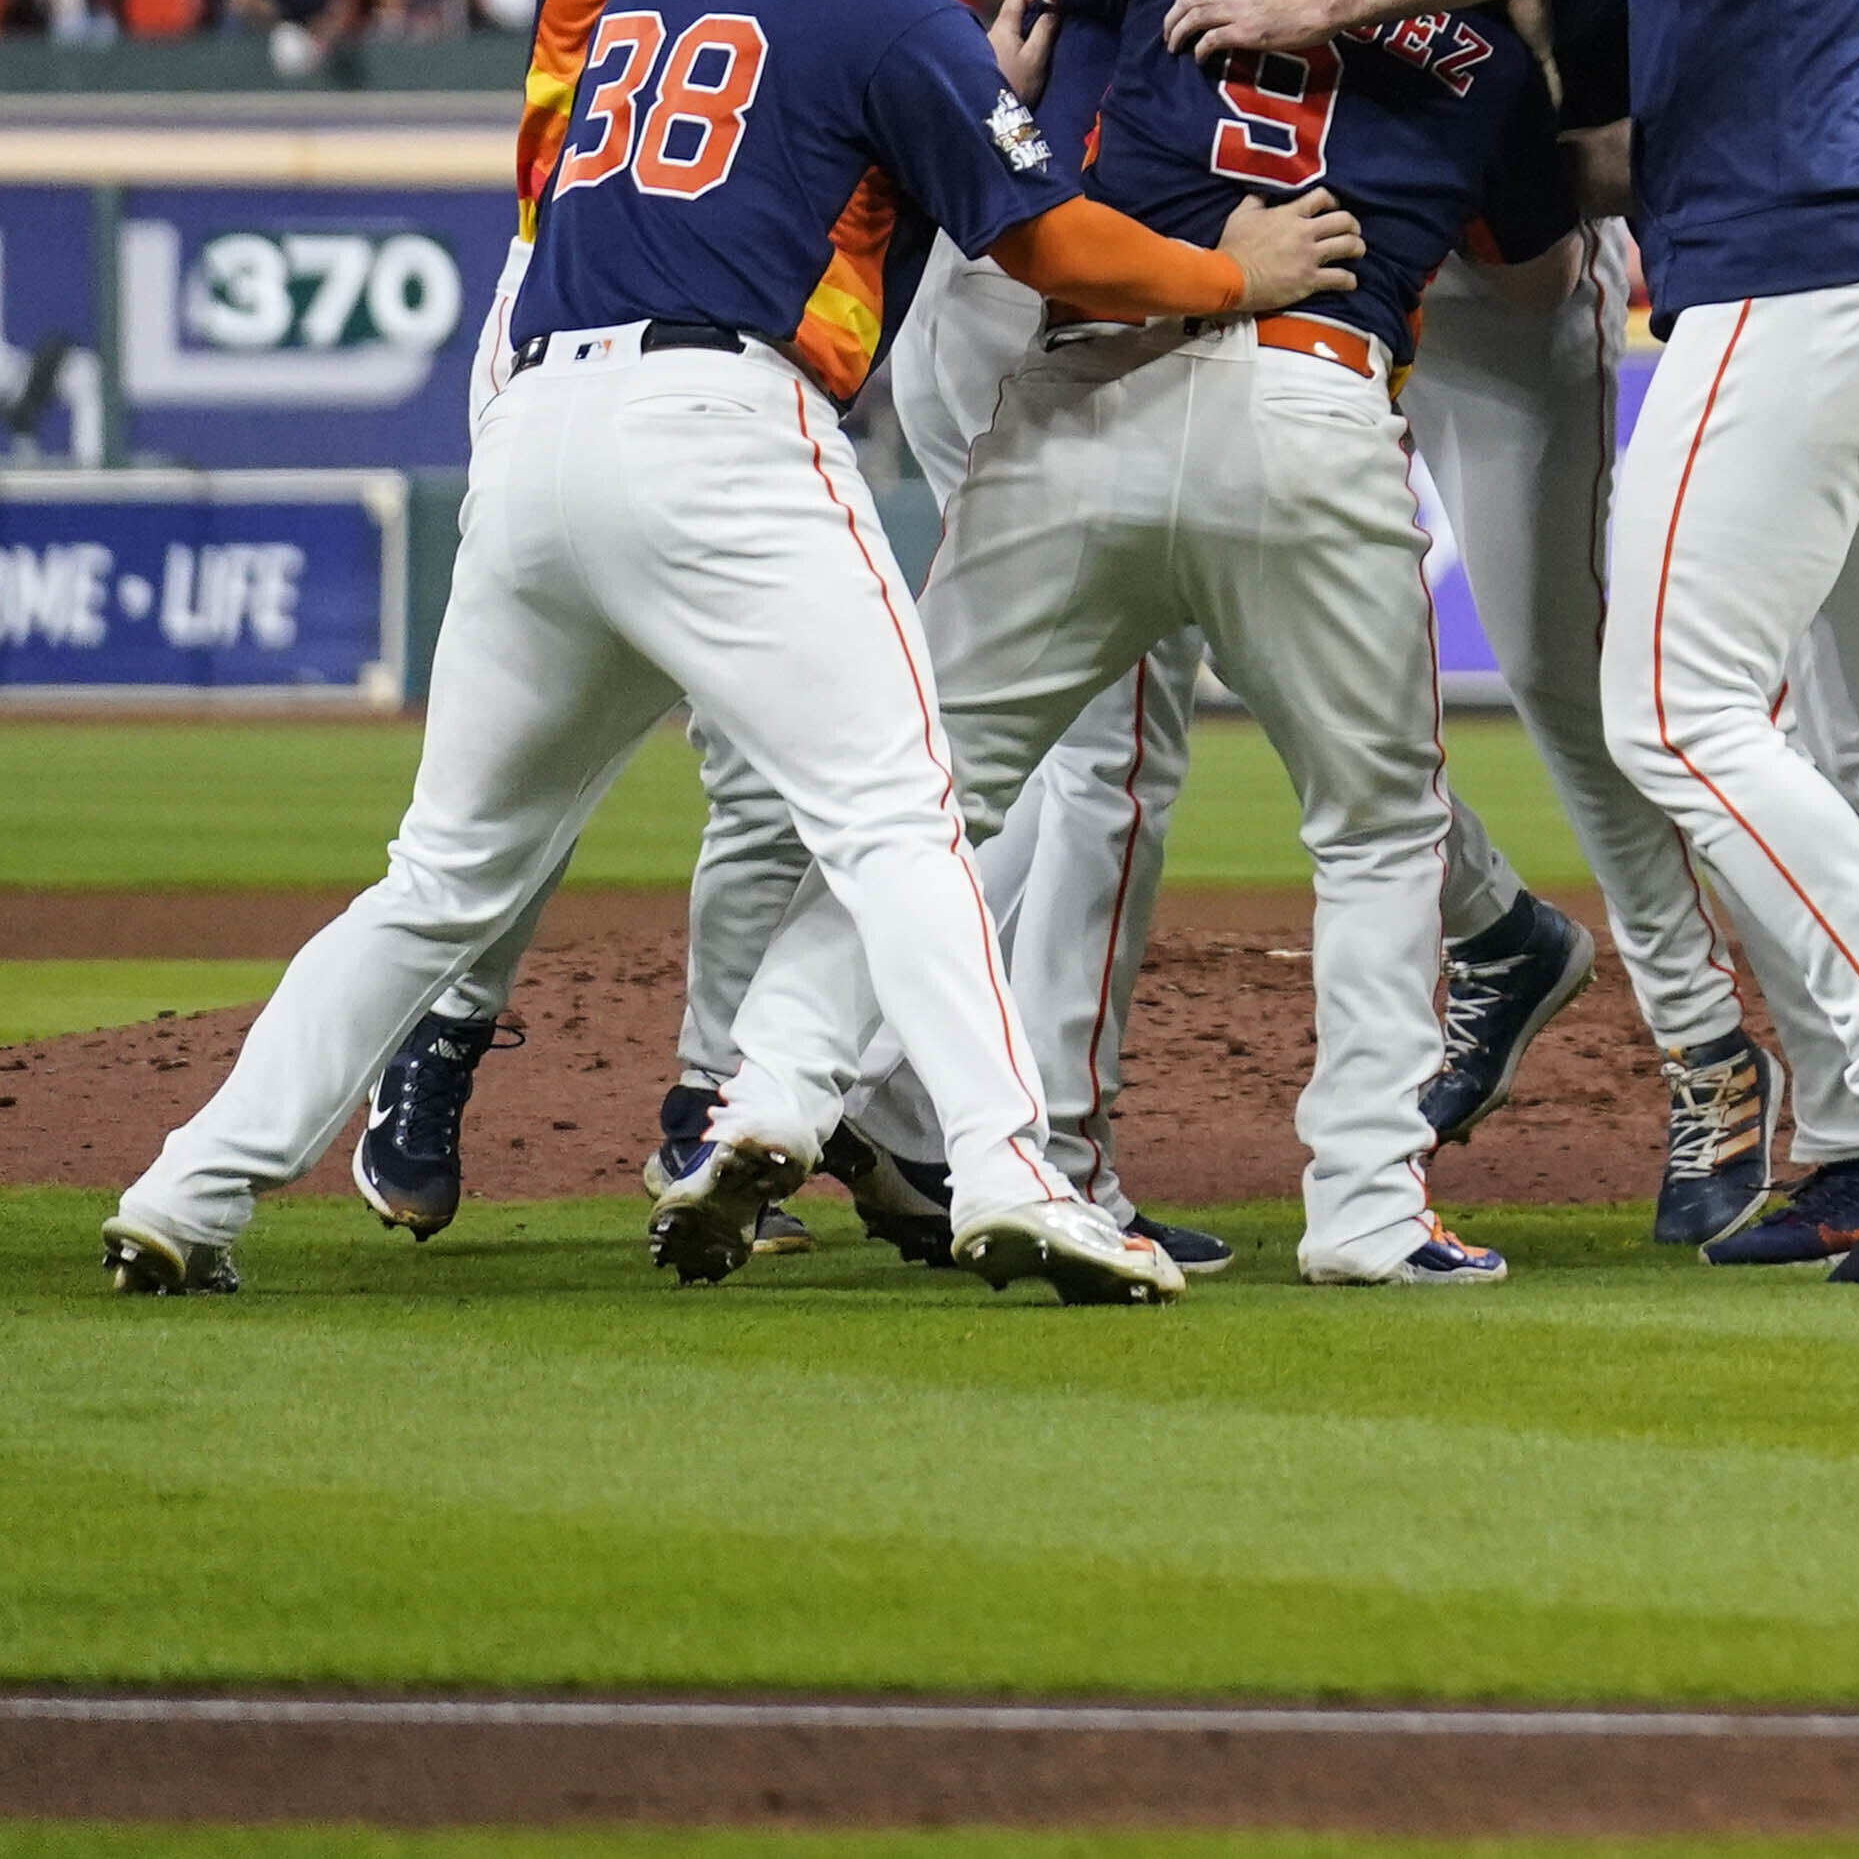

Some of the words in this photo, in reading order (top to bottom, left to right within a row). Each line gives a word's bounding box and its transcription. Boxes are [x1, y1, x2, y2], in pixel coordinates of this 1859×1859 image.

[552, 11, 769, 201] 38
[1210, 38, 1344, 189] 9
[198, 233, 462, 349] 370
[160, 541, 307, 651] LIFE
